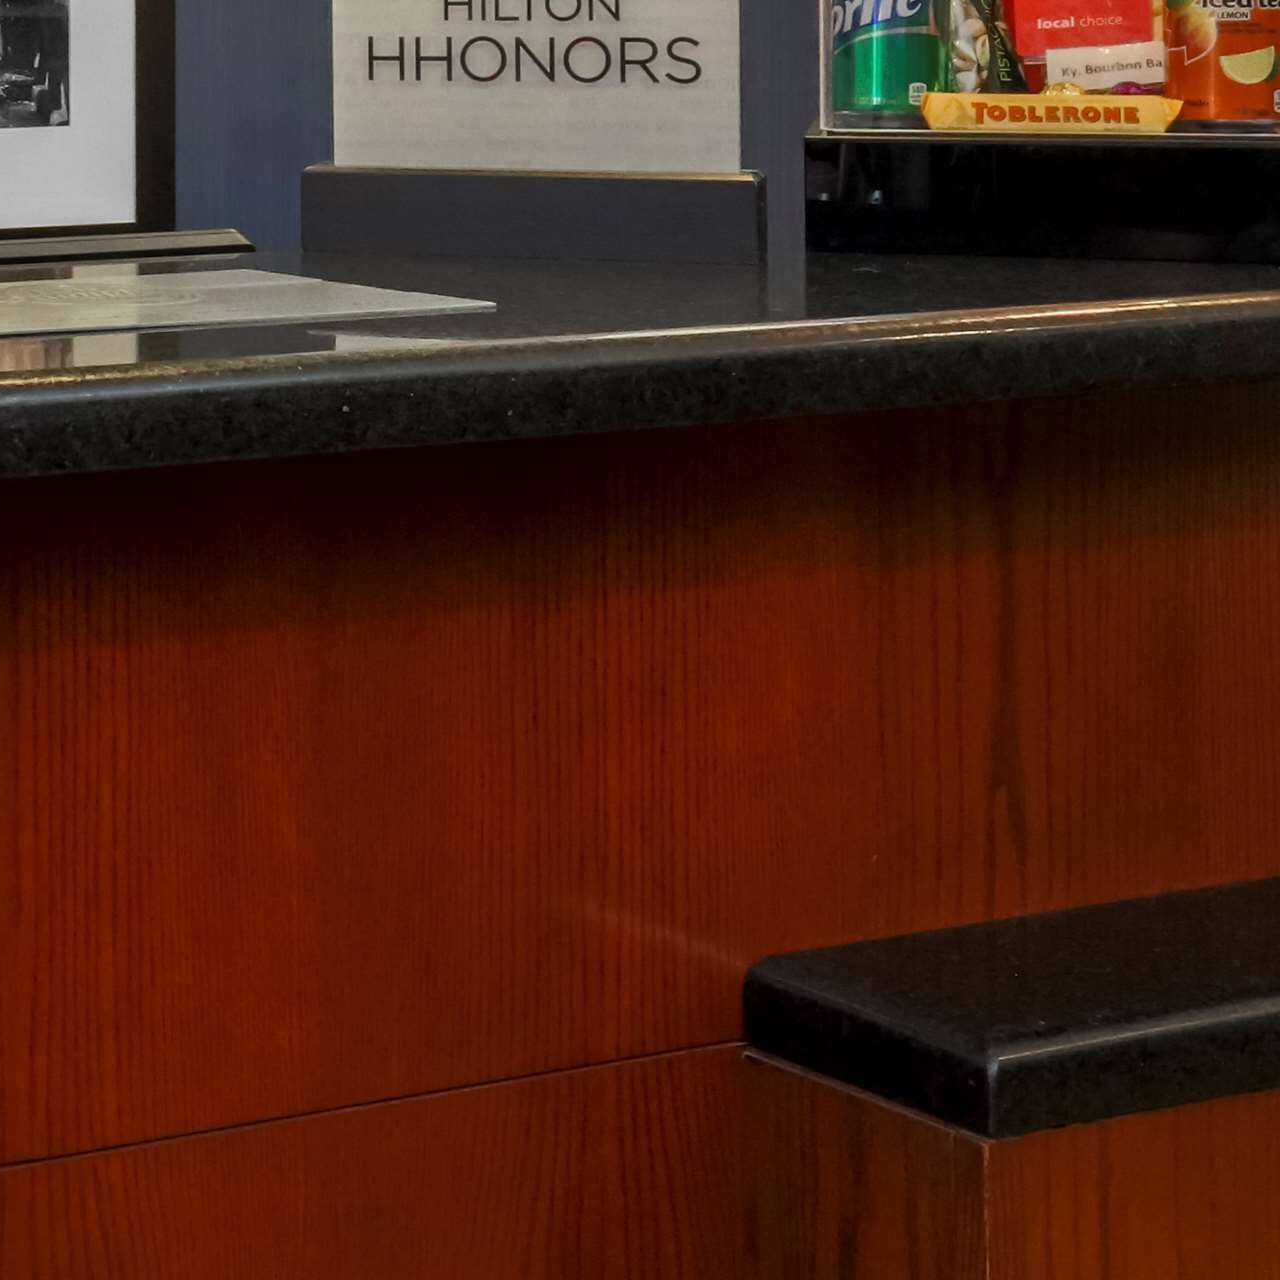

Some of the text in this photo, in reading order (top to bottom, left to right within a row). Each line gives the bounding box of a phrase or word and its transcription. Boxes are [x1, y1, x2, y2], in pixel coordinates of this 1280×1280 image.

[1037, 14, 1124, 30] local choice
[1216, 10, 1249, 20] LEMON
[367, 36, 703, 85] HHONORS
[971, 102, 1140, 125] TOBLERONE
